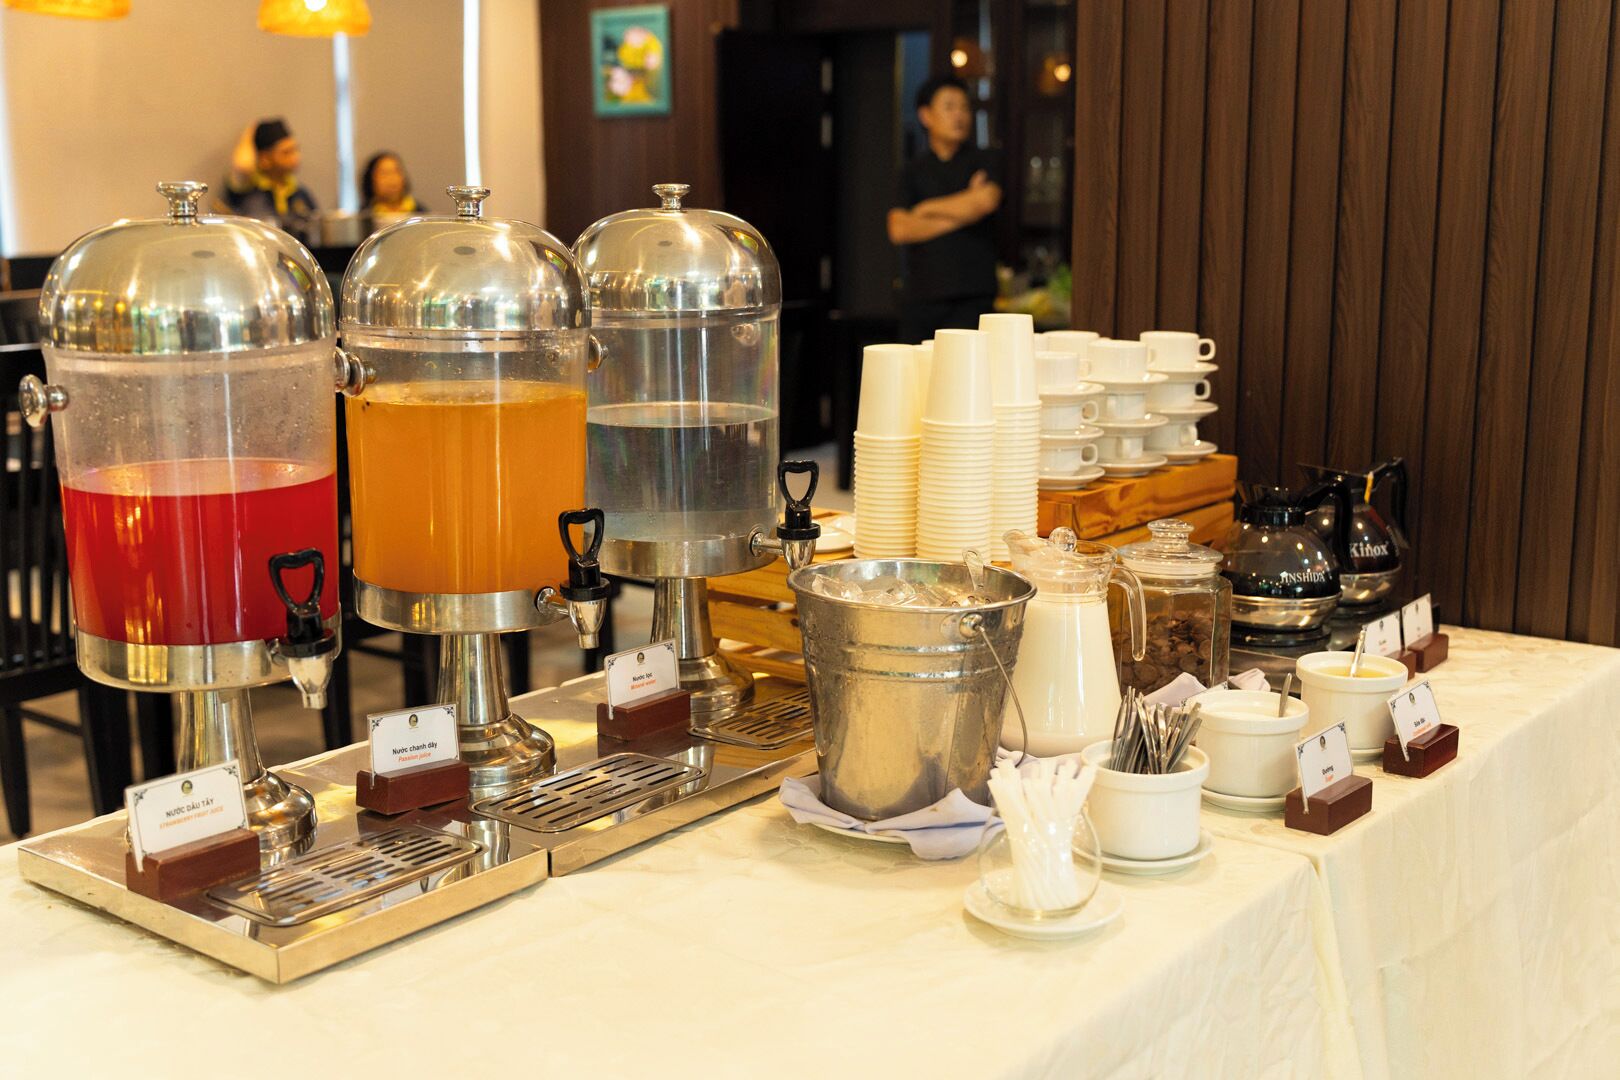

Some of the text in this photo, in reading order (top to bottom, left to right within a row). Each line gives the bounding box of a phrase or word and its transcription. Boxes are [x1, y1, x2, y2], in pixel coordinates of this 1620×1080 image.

[1350, 541, 1389, 557] Kinox
[392, 741, 438, 755] Nước chanh dây
